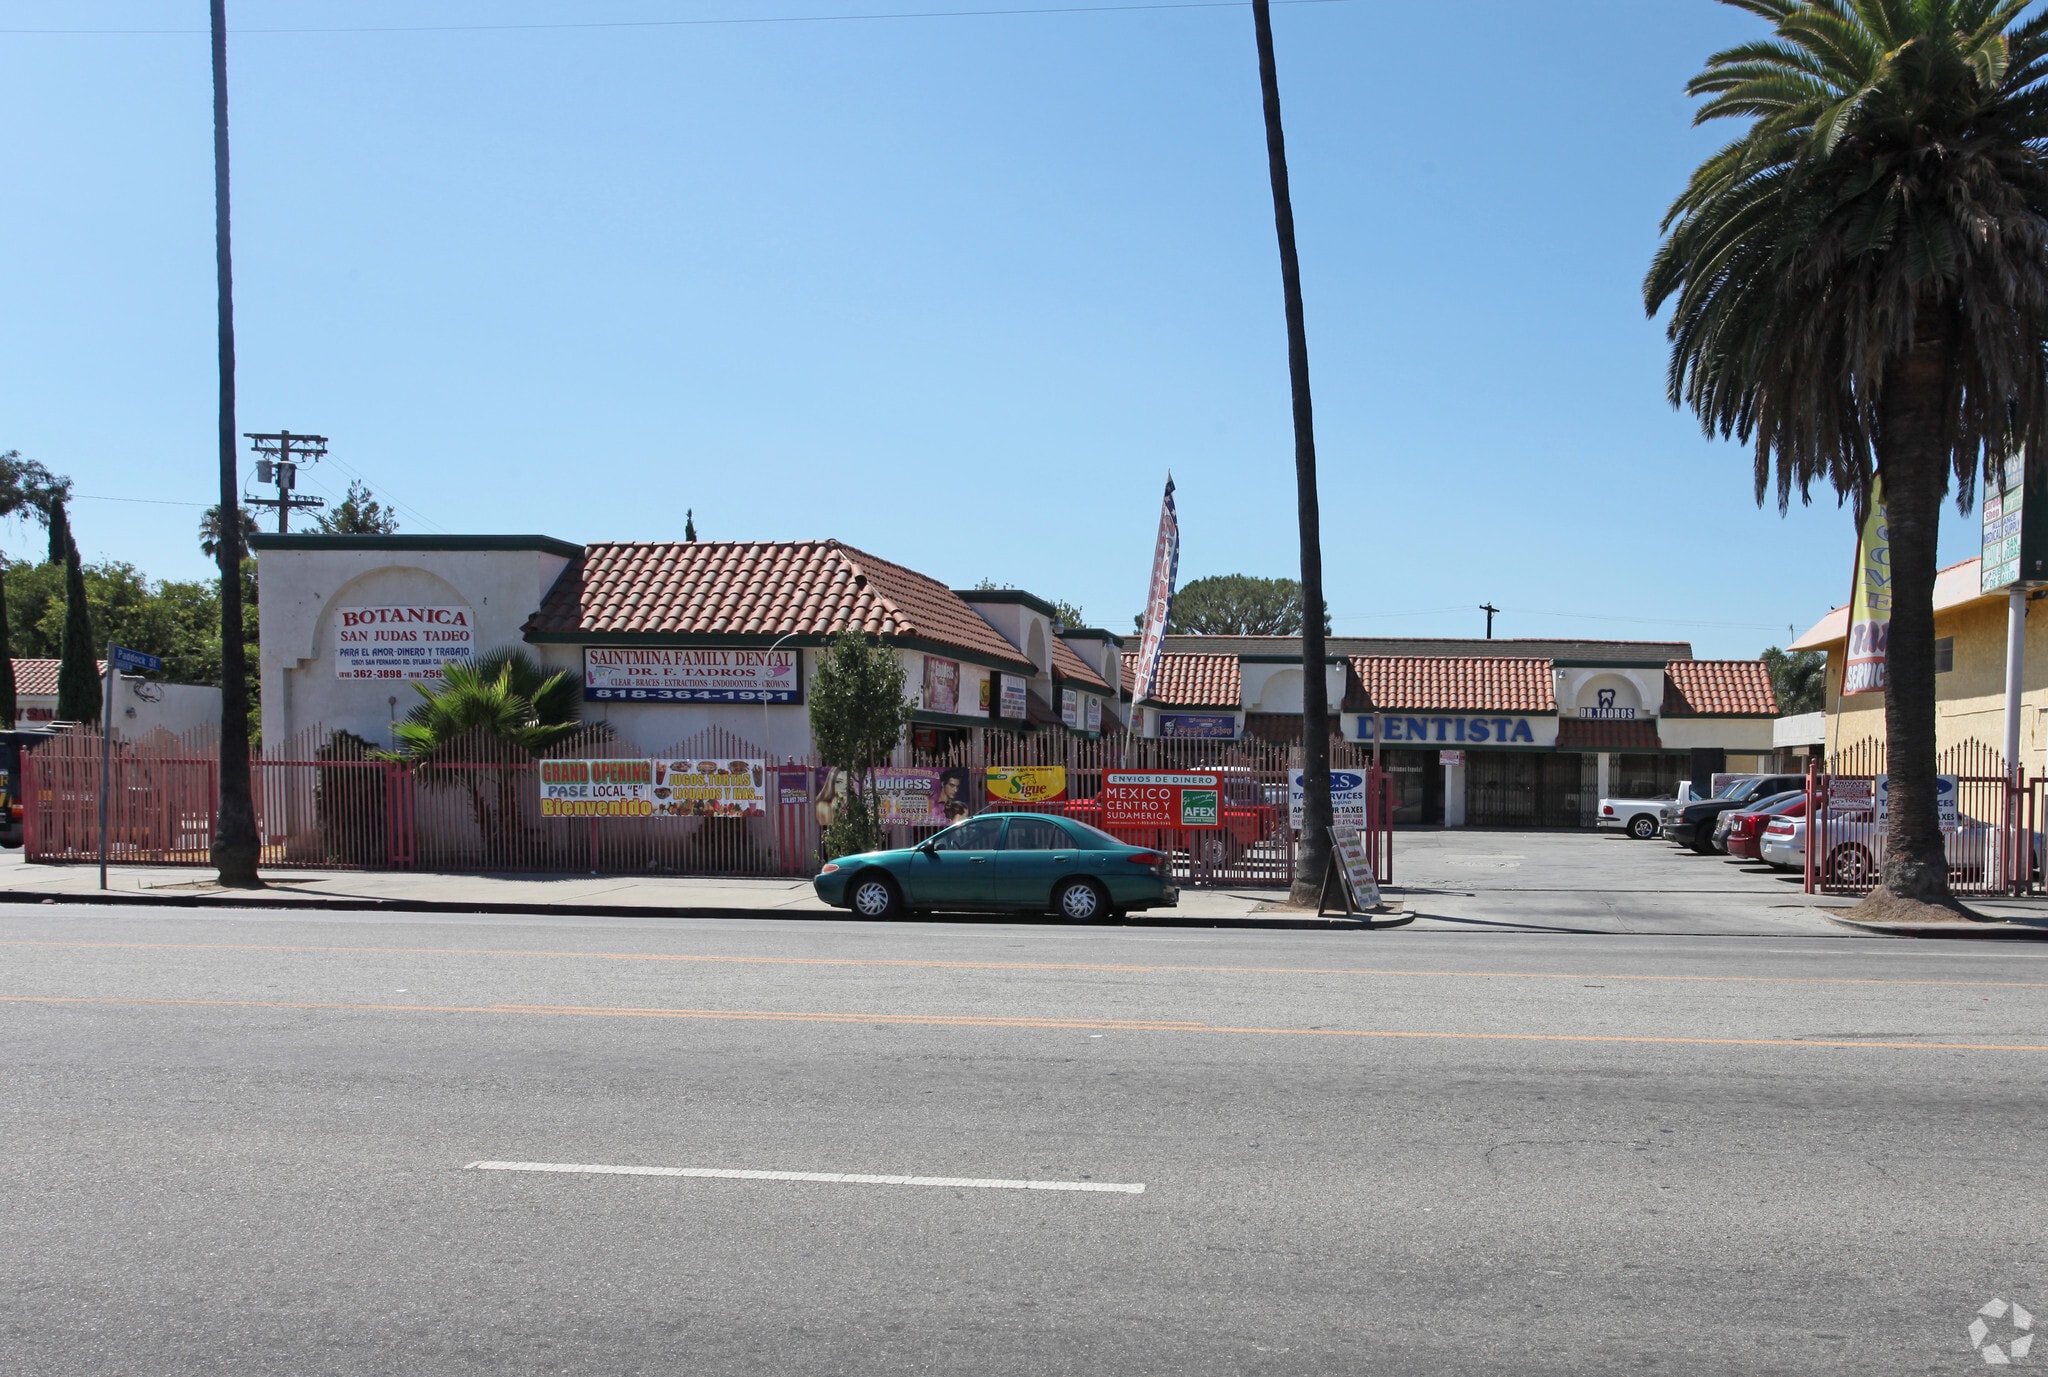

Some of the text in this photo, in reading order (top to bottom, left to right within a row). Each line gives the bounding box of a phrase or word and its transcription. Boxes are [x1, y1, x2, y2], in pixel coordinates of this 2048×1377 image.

[1992, 513, 2016, 529] ALLANCE
[343, 608, 468, 627] BOTANICA
[341, 631, 470, 641] SAN JUDAS TADEO
[340, 648, 359, 656] PARA
[362, 648, 370, 656] EL
[428, 648, 433, 656] Y
[436, 647, 470, 657] TRABAJO
[117, 649, 146, 665] Paddock
[149, 657, 157, 667] St
[590, 650, 793, 667] SAINTMINA FAMILY DENTAL
[353, 669, 402, 678] 362-3898
[628, 667, 756, 677] DR. F. TADROS
[611, 678, 632, 687] CLEAR
[635, 679, 660, 687] BRACES
[664, 679, 708, 688] EXTRACTIONS
[712, 680, 757, 688] ENDODONTICS
[595, 689, 789, 701] 818-364-1991
[1357, 716, 1534, 742] DENTISTA
[542, 761, 650, 784] GRAND OPENING
[1172, 776, 1212, 784] DINERO
[548, 786, 588, 797] PASE
[593, 786, 625, 797] LOCAL
[1009, 775, 1047, 797] Sigue
[673, 788, 722, 799] LICUADOS
[725, 788, 731, 799] Y
[1106, 788, 1170, 799] MEXICO
[541, 798, 652, 816] Bienvenido
[1107, 801, 1170, 810] CENTRO Y
[1341, 806, 1363, 814] TAXES
[1107, 812, 1170, 820] SUDAMERICA
[1184, 807, 1215, 817] AFEX
[1938, 813, 1955, 821] XES
